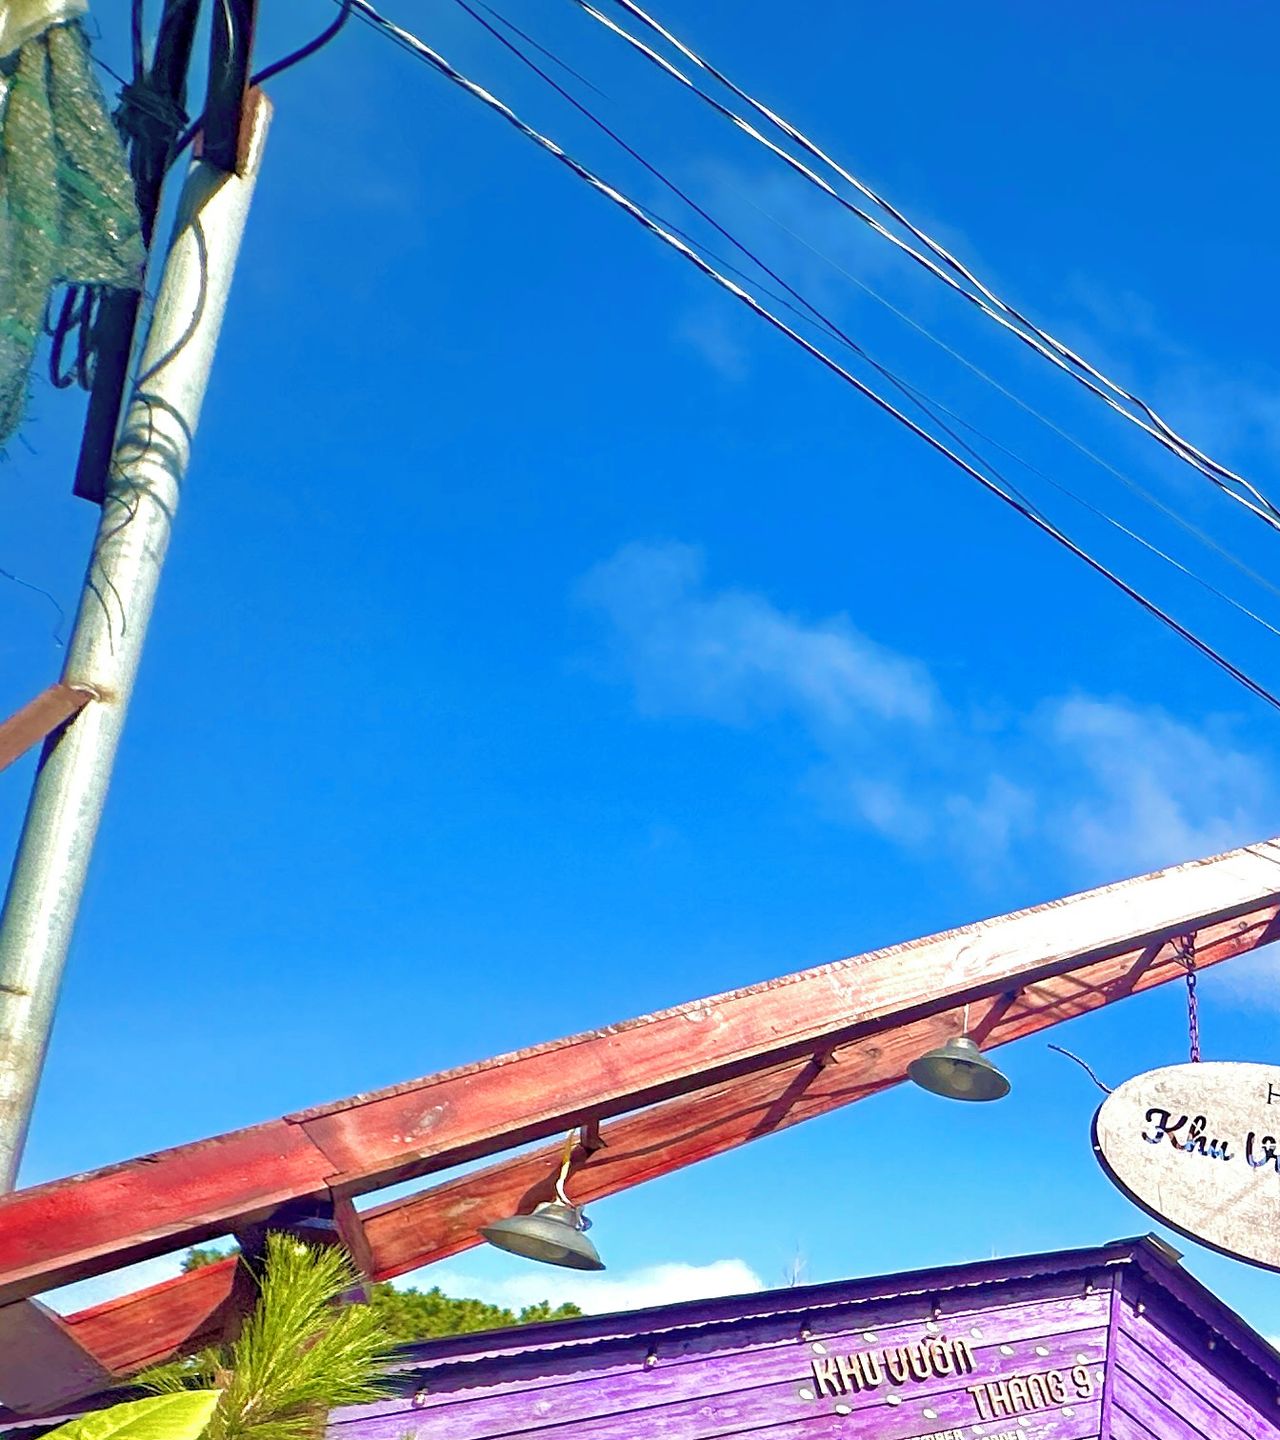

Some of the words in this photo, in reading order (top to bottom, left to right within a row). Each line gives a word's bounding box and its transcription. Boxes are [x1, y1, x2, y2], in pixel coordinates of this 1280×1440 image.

[1141, 1107, 1235, 1162] Khu
[811, 1350, 884, 1399] KHU
[966, 1369, 1068, 1420] THÁNG
[1070, 1365, 1095, 1399] 9
